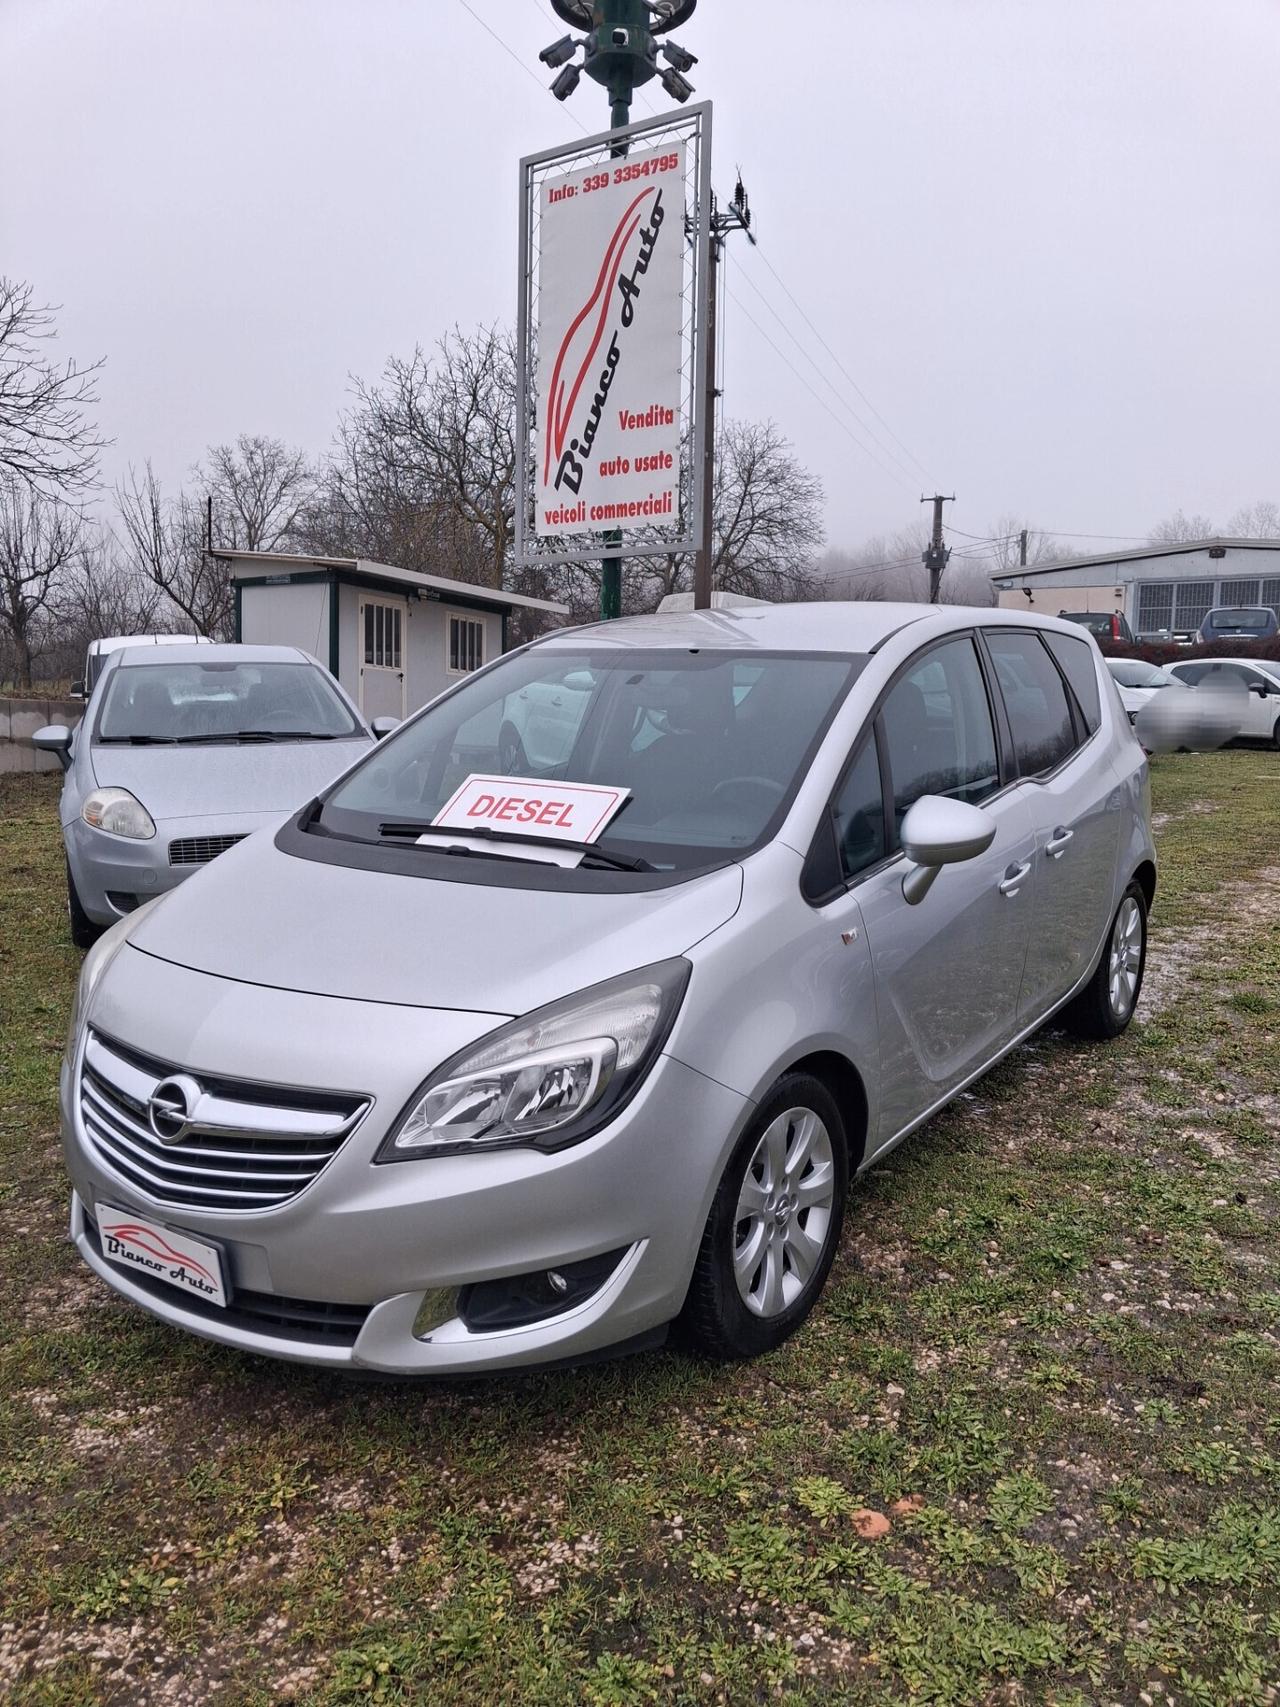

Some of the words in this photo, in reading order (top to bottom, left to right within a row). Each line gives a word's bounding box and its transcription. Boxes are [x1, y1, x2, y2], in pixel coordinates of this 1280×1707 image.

[549, 184, 579, 203] Info:
[583, 173, 609, 193] 339
[614, 153, 678, 184] 3354795
[554, 330, 620, 495] Bianco
[618, 188, 664, 328] Auto
[619, 404, 674, 431] Vendita
[600, 456, 629, 476] auto
[635, 451, 673, 472] usate
[545, 501, 586, 524] veicoli
[590, 491, 672, 520] commerciali
[467, 795, 574, 827] DIESEL
[104, 1235, 167, 1272] Bianco
[169, 1266, 218, 1295] Auto
